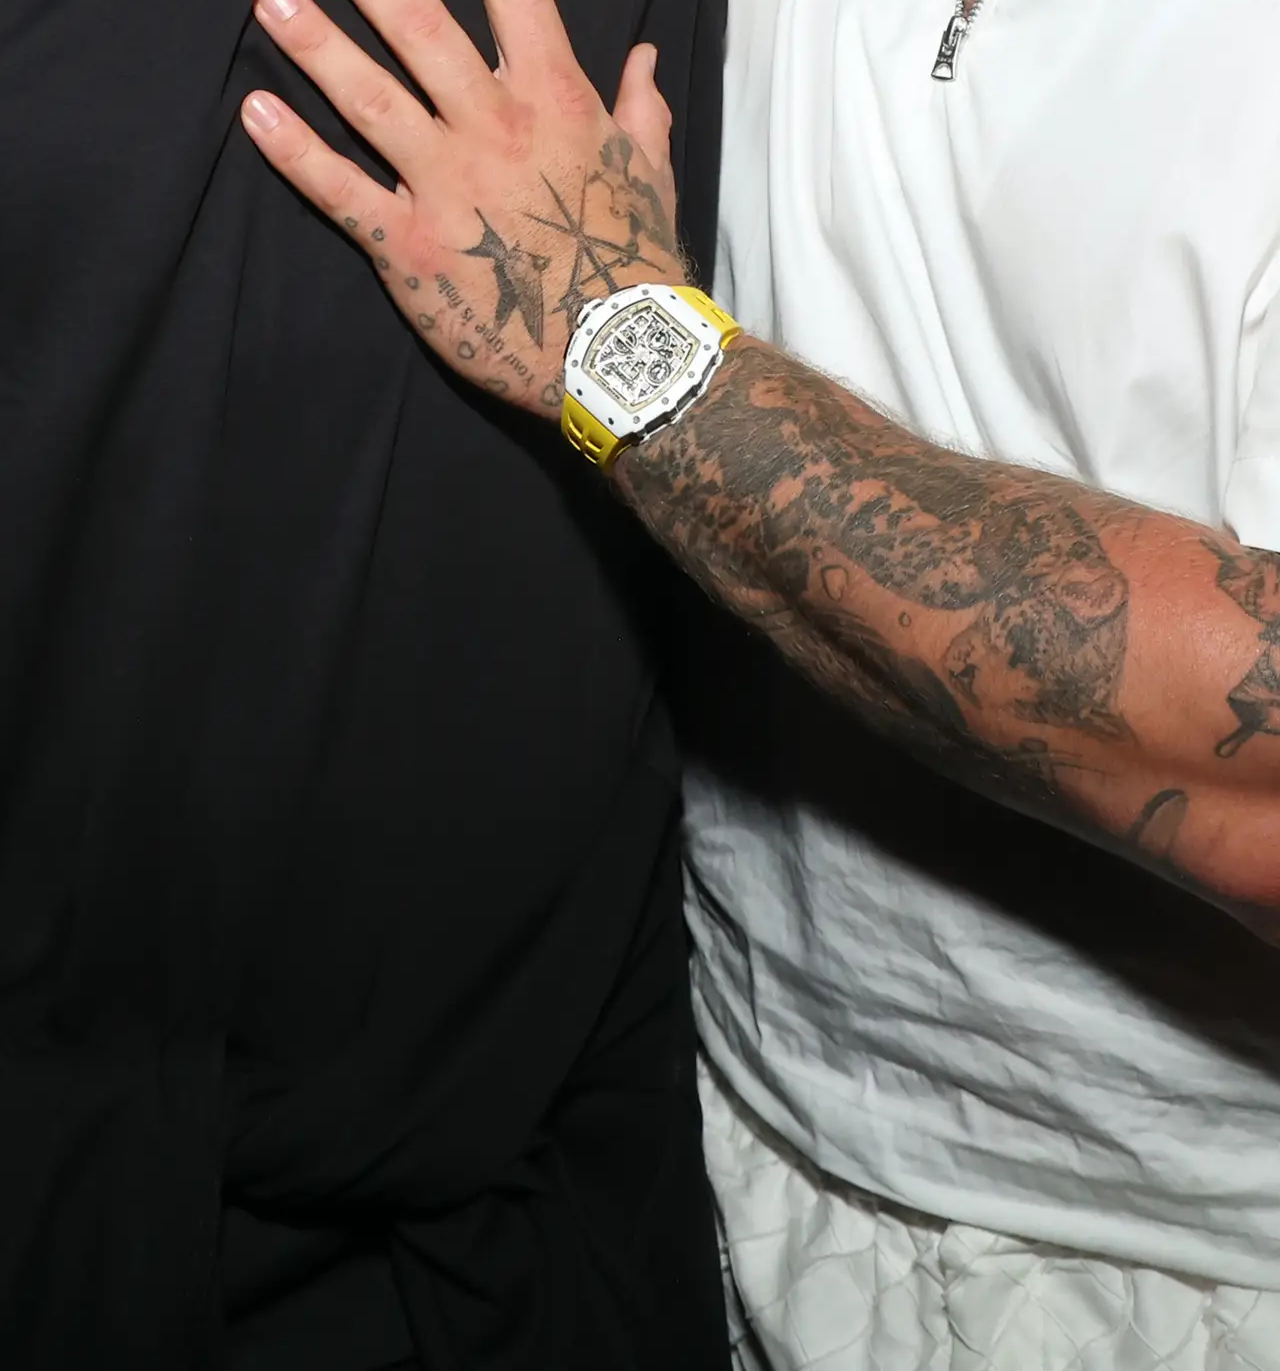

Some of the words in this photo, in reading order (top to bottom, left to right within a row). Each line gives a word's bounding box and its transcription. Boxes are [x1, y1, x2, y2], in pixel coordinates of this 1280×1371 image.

[461, 308, 475, 326] is
[475, 323, 506, 354] time
[502, 353, 534, 387] Your
